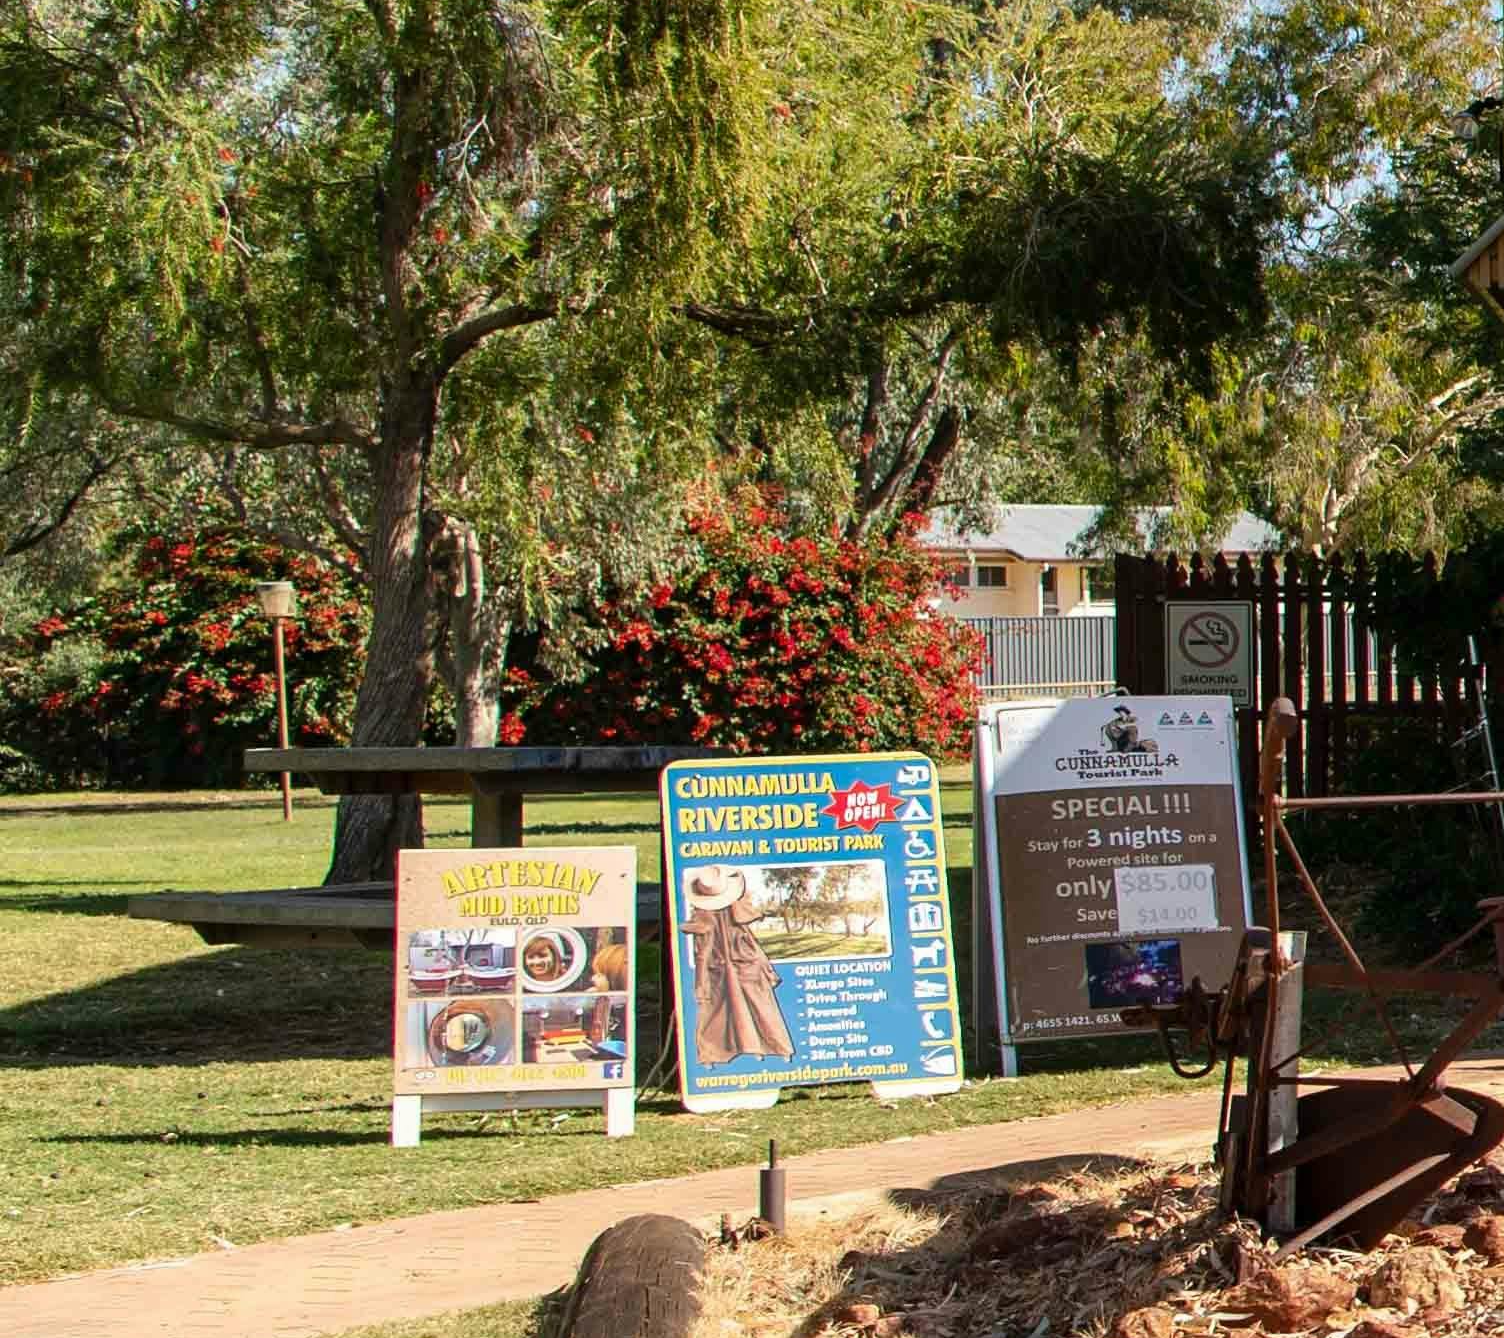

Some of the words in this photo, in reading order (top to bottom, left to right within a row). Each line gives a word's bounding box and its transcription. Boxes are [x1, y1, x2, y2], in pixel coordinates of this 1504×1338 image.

[1182, 675, 1238, 687] SMOKING
[1078, 748, 1099, 756] The
[1055, 753, 1179, 772] CUNNAMULLA
[1077, 768, 1128, 780] Tourist
[1130, 766, 1164, 778] Park
[846, 790, 879, 807] NOW
[1051, 794, 1159, 820] SPECIAL
[1162, 792, 1193, 815] !!!
[678, 802, 820, 833] RIVERSIDE
[844, 804, 887, 822] OPEN!
[679, 839, 754, 858] CARAVAN
[758, 837, 771, 855] &
[774, 835, 841, 854] TOURIST
[844, 833, 885, 851] PARK
[1027, 838, 1059, 854] Stay
[1063, 836, 1083, 850] for
[1087, 827, 1102, 848] 3
[1109, 825, 1183, 850] nights
[1188, 832, 1204, 844] on
[1208, 832, 1217, 844] a
[1067, 855, 1131, 870] Powered
[1134, 852, 1159, 865] site
[1162, 851, 1184, 864] for
[440, 860, 605, 900] ARTESIAN
[1055, 874, 1112, 900] only
[1120, 869, 1209, 897] $85.00
[459, 894, 507, 918] MUD
[511, 891, 580, 917] BATHS
[524, 915, 549, 926] QLD
[1076, 907, 1118, 922] Save
[794, 963, 831, 977] QUIET
[832, 960, 893, 974] LOCATION
[868, 1044, 895, 1057] CBD
